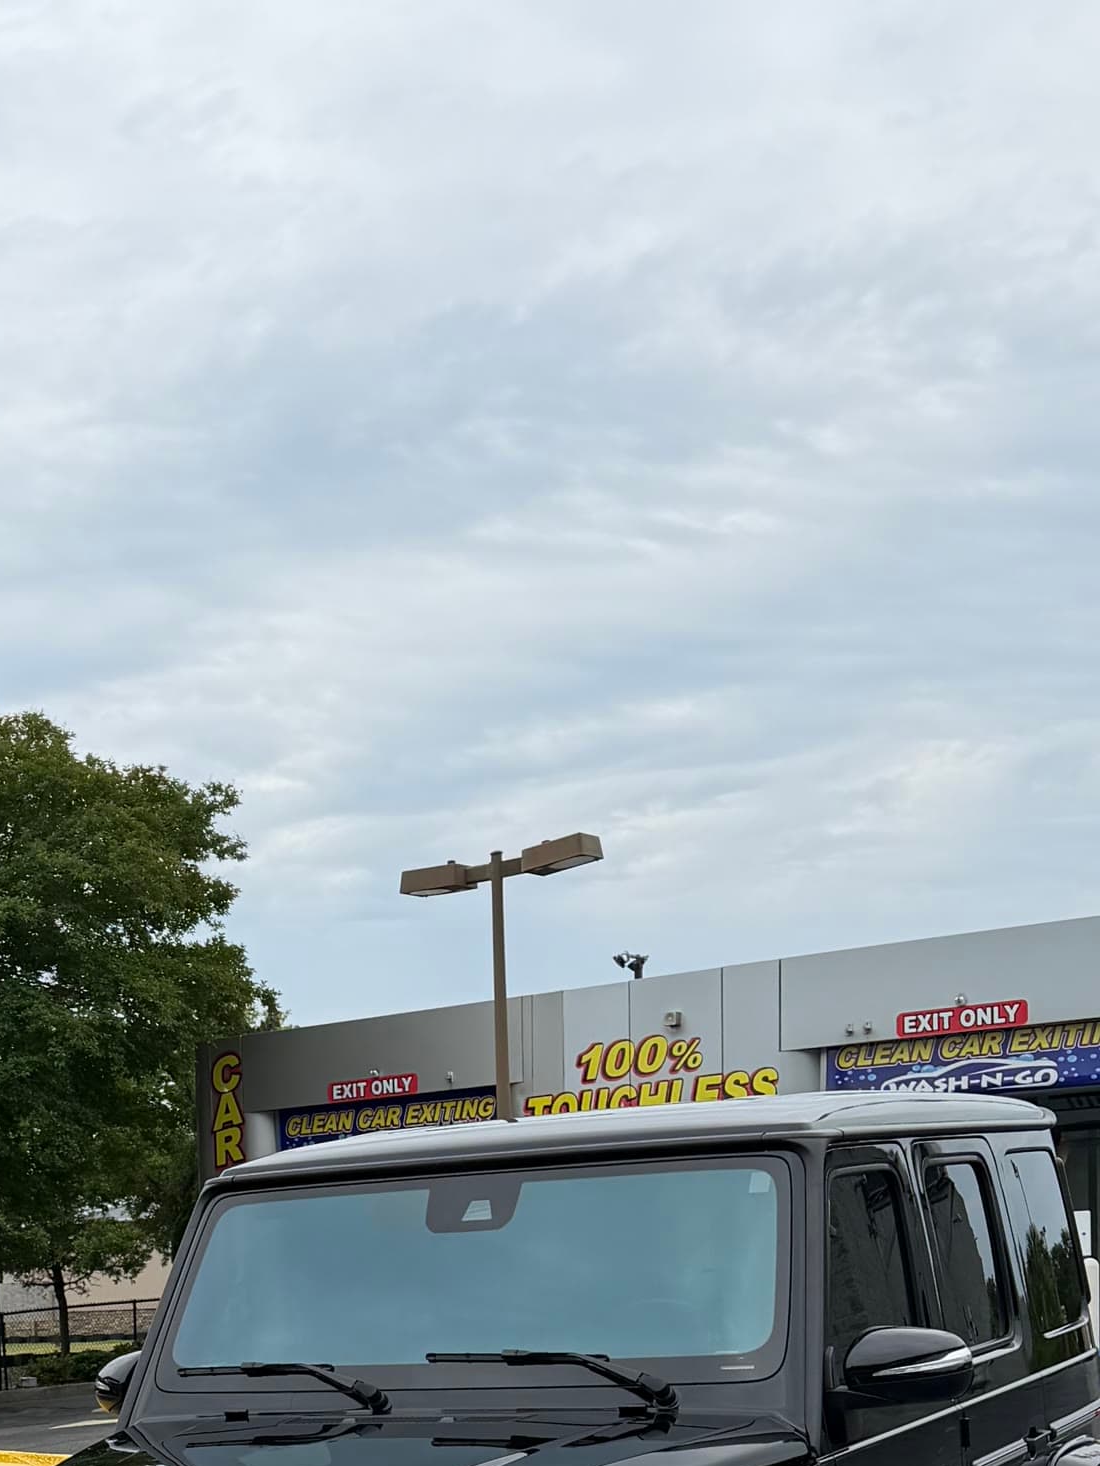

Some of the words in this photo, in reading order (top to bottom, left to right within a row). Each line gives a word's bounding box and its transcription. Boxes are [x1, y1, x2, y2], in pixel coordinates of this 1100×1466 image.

[903, 1011, 953, 1034] EXIT
[960, 1004, 1020, 1027] ONLY
[576, 1035, 703, 1084] 100%
[836, 1040, 934, 1070] CLEAN
[939, 1030, 1005, 1060] CAR
[331, 1081, 367, 1101] EXIT
[371, 1076, 413, 1095] ONLY
[212, 1053, 245, 1167] CAR
[286, 1110, 354, 1138] CLEAN
[357, 1105, 402, 1131] CAR
[405, 1096, 496, 1127] EXITING
